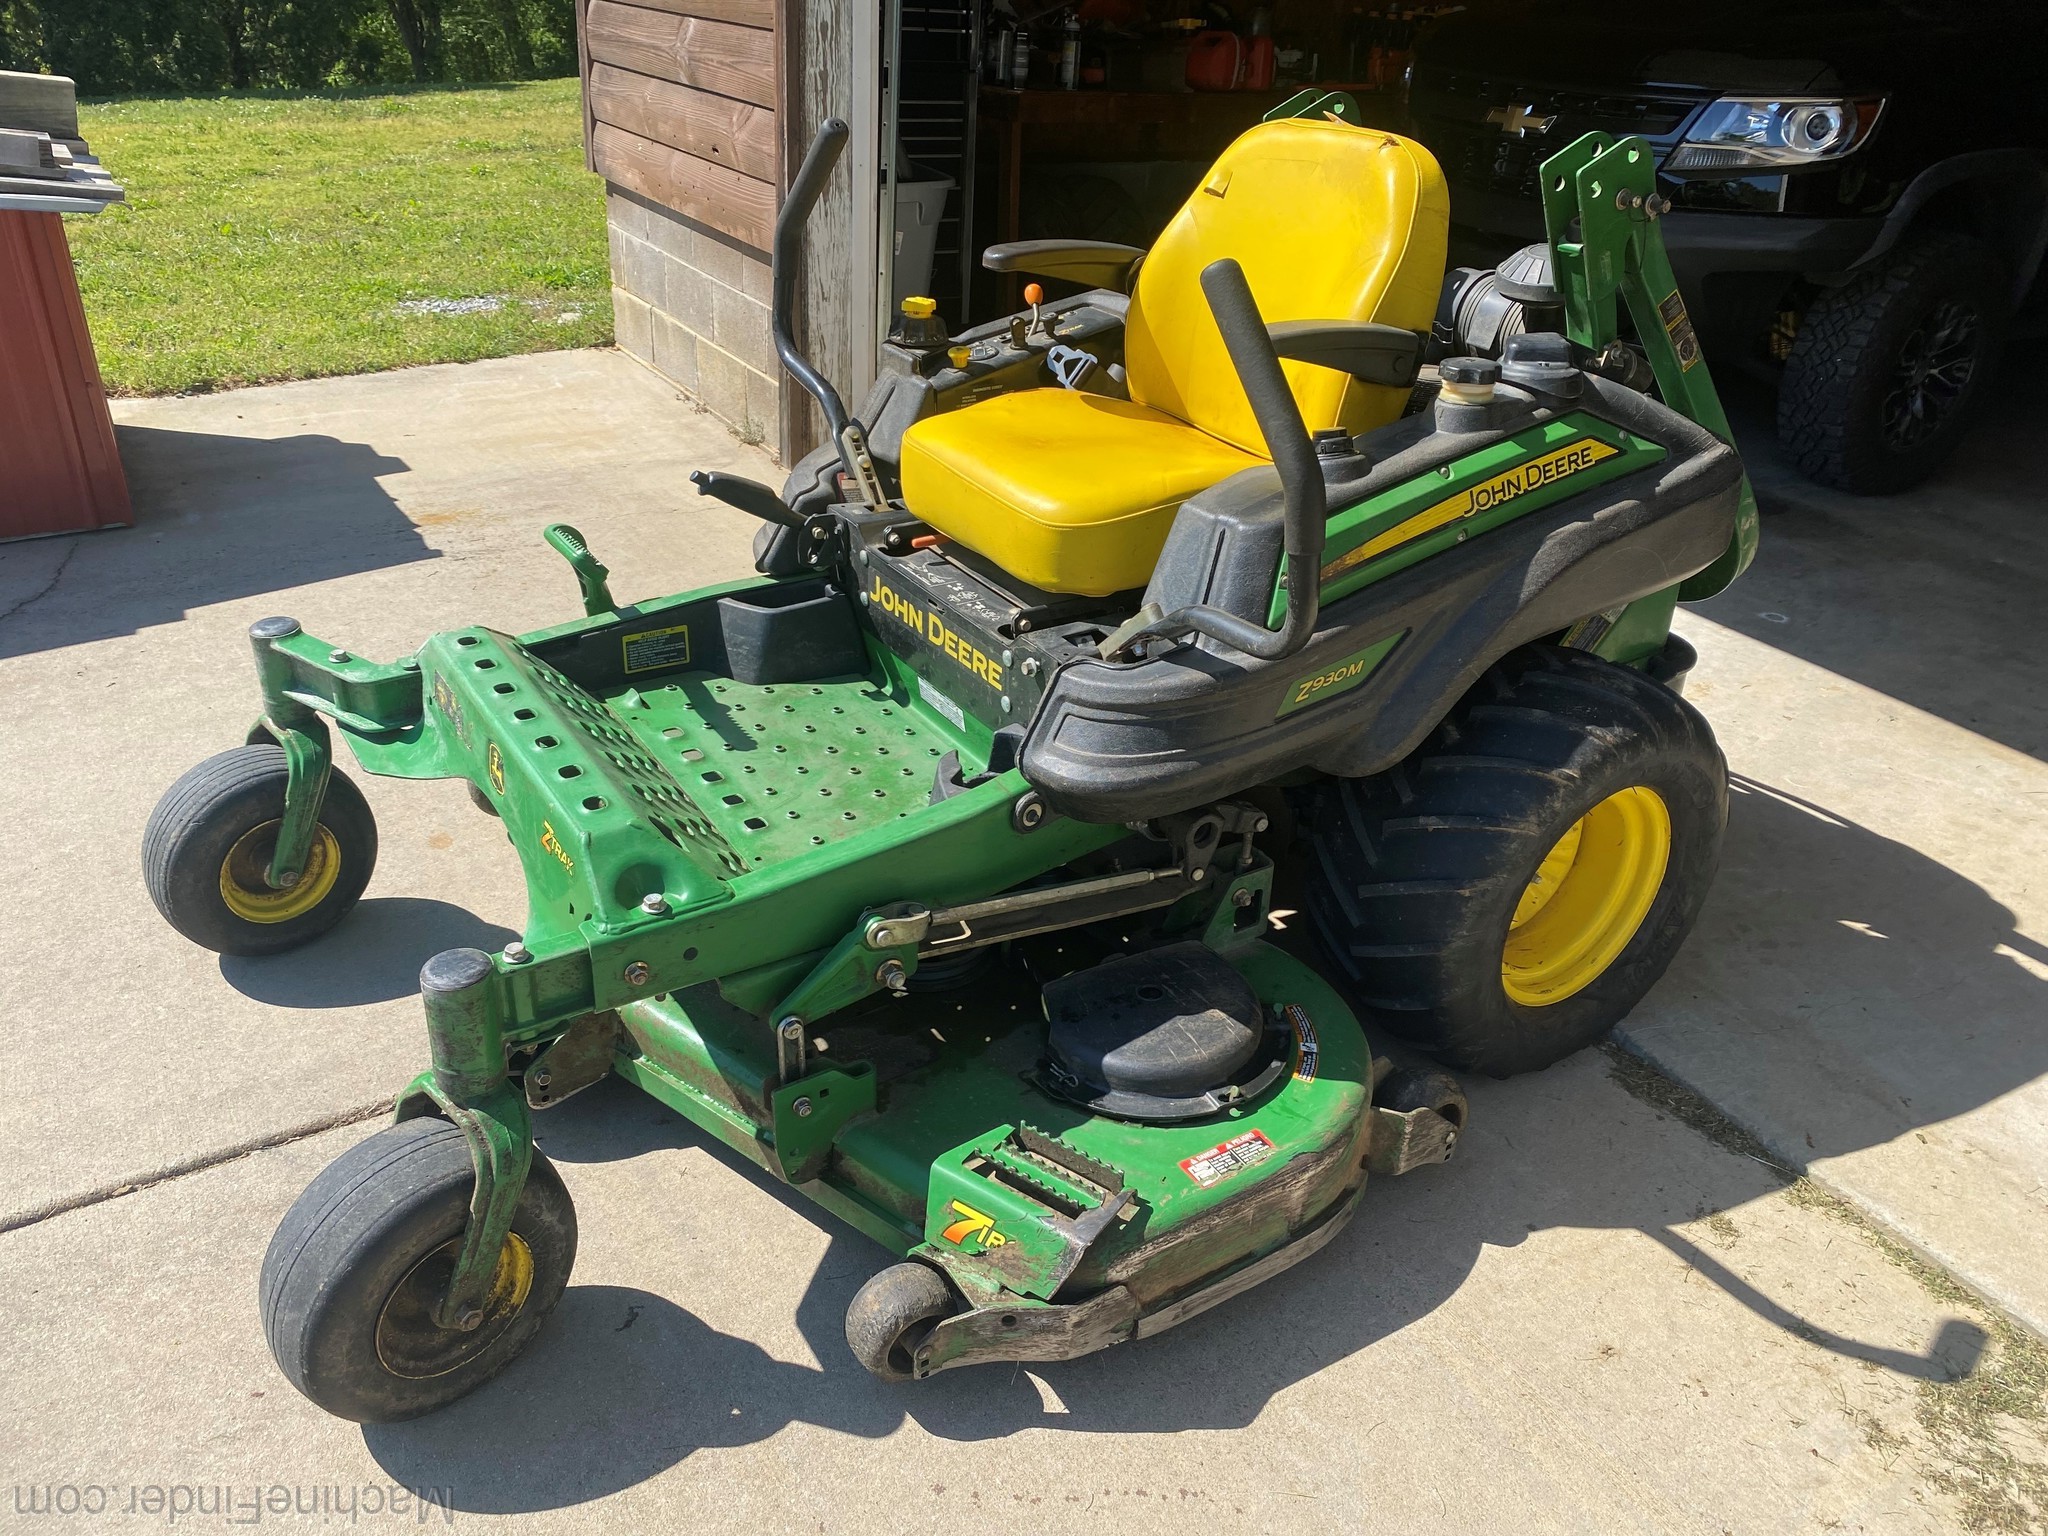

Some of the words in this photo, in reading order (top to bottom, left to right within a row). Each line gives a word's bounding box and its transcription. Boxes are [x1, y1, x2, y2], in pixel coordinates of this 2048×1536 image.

[1463, 474, 1525, 517] JOHN
[1525, 446, 1595, 491] DEERE
[870, 575, 923, 635] JOHN
[928, 612, 1003, 692] DEERE
[1294, 659, 1365, 703] Z930M
[941, 1199, 1016, 1248] 7IR
